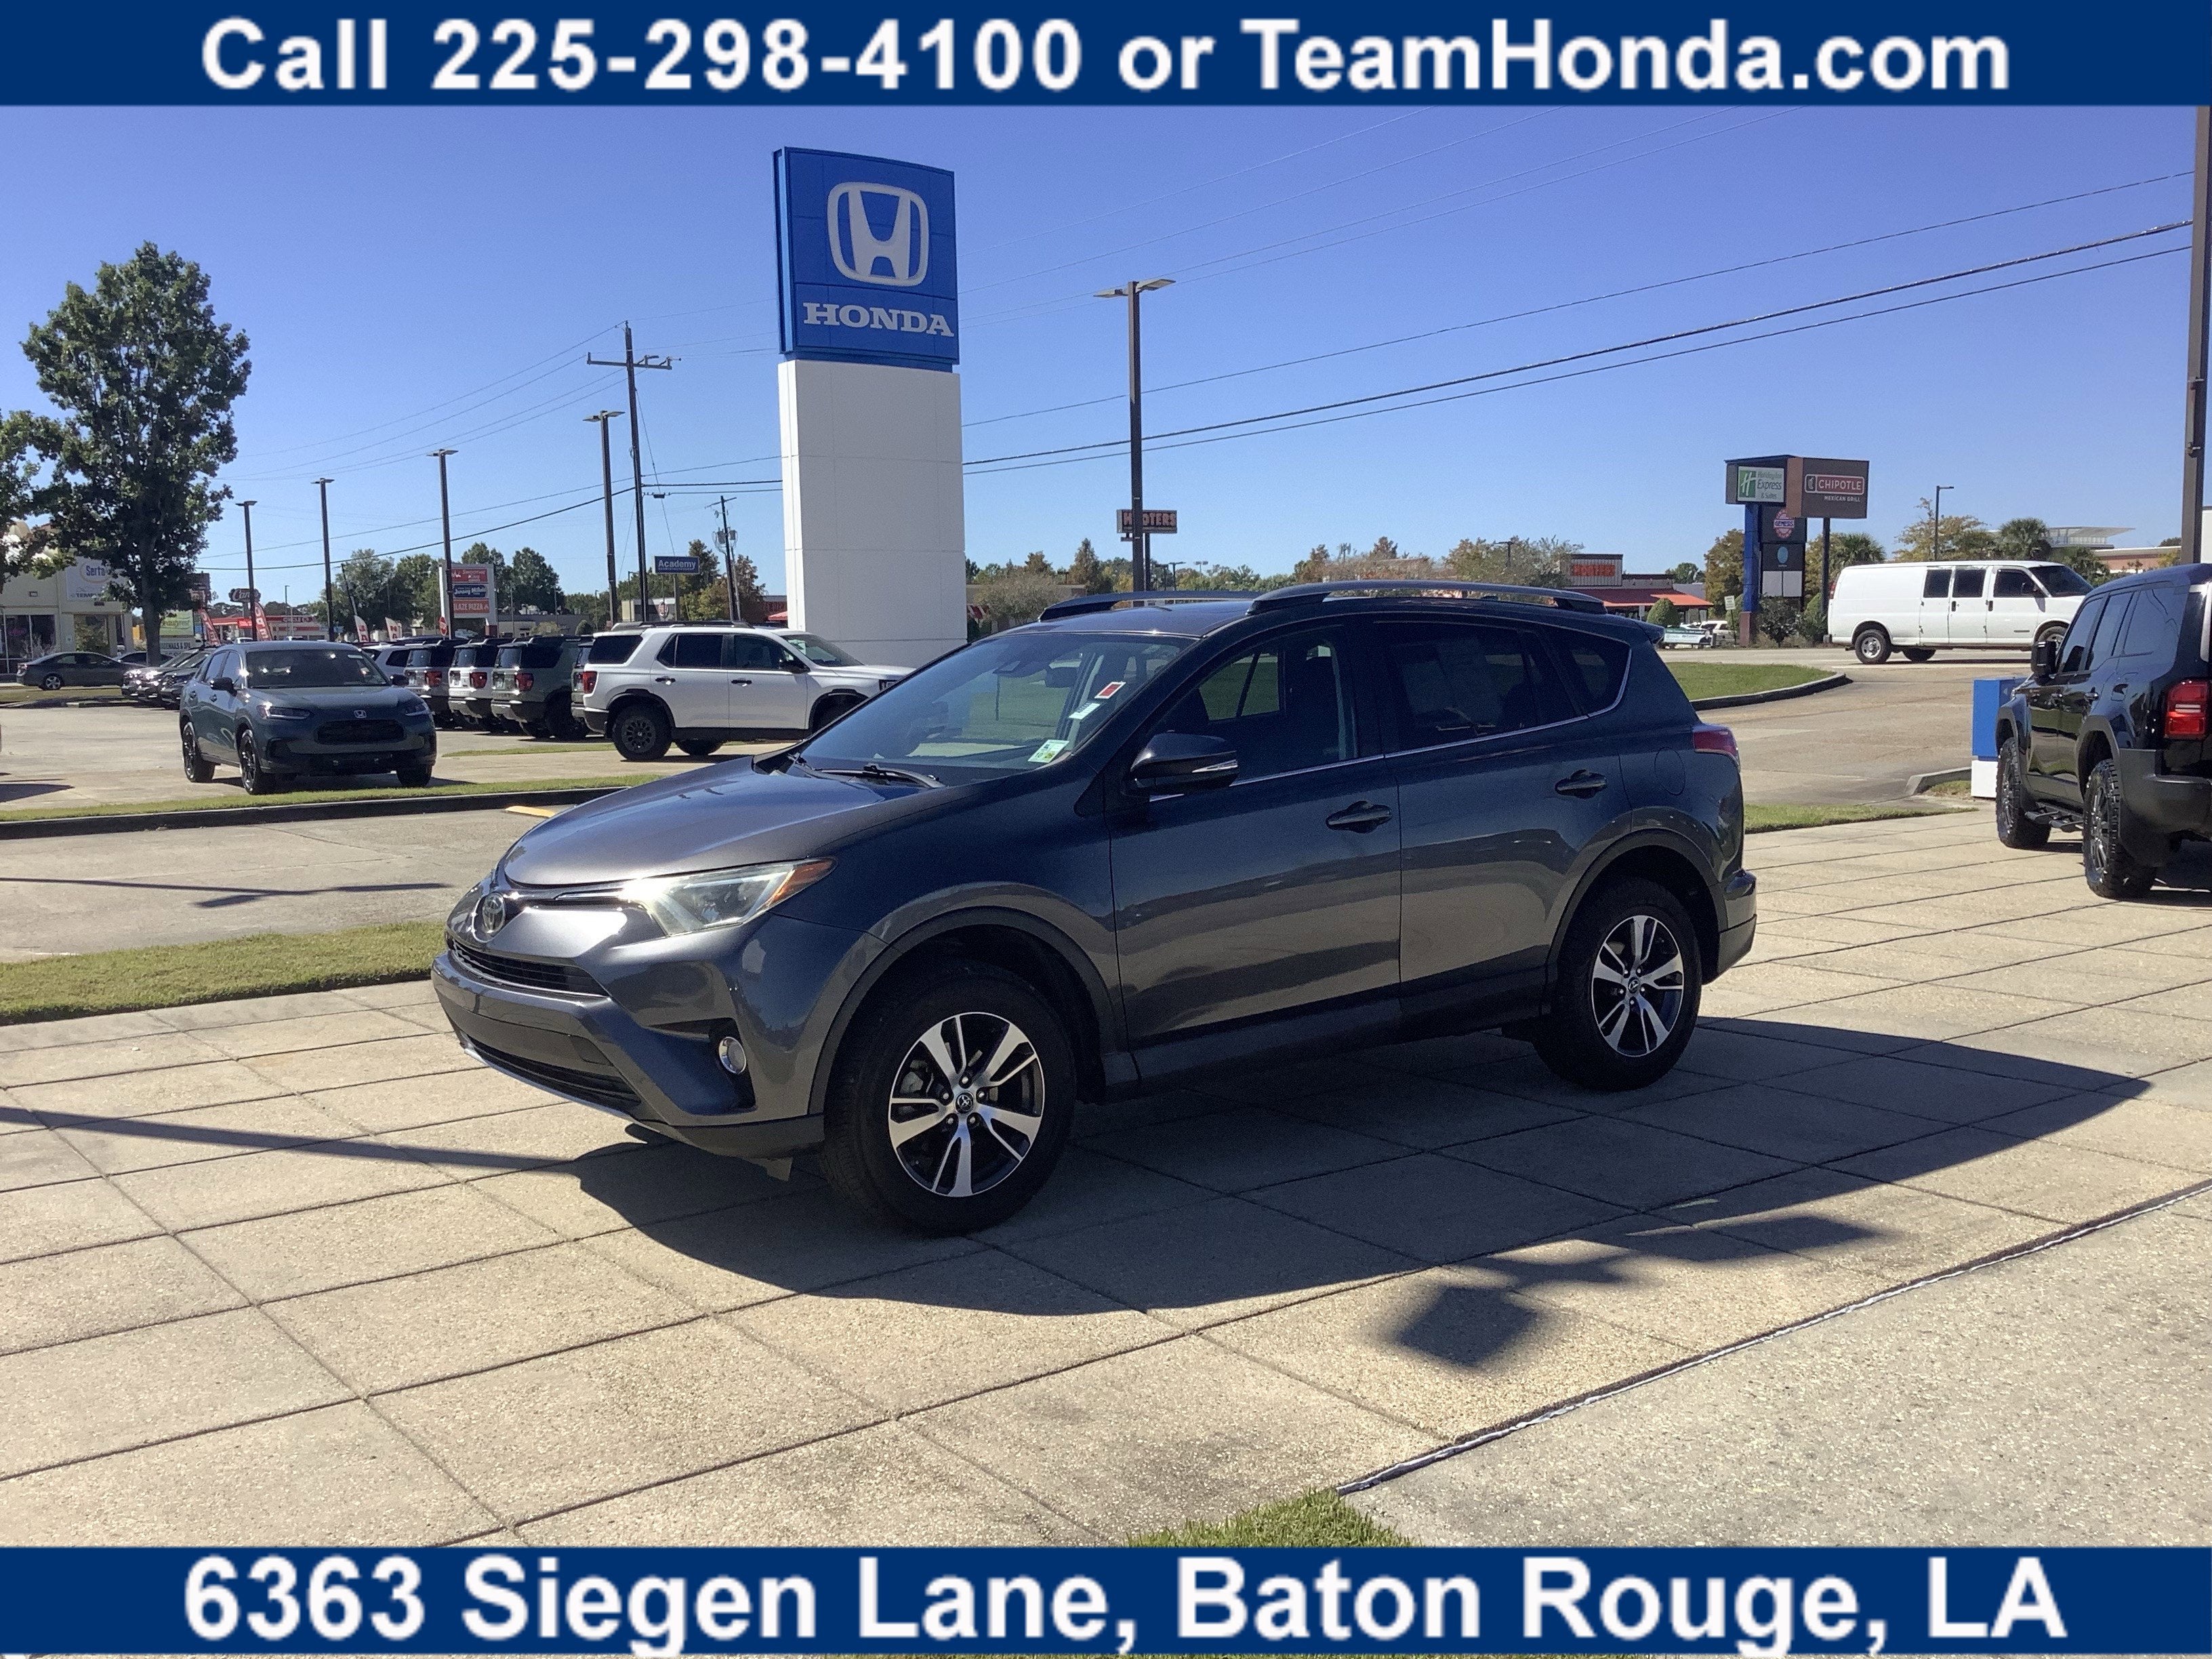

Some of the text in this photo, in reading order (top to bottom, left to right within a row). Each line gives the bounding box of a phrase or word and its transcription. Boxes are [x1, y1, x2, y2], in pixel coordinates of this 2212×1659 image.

[802, 302, 954, 337] HONDA
[1757, 478, 1782, 492] Express
[1818, 479, 1862, 491] CHIPOTLE
[1123, 512, 1176, 526] HOTERS
[85, 565, 106, 576] Serta
[658, 559, 696, 571] Academy
